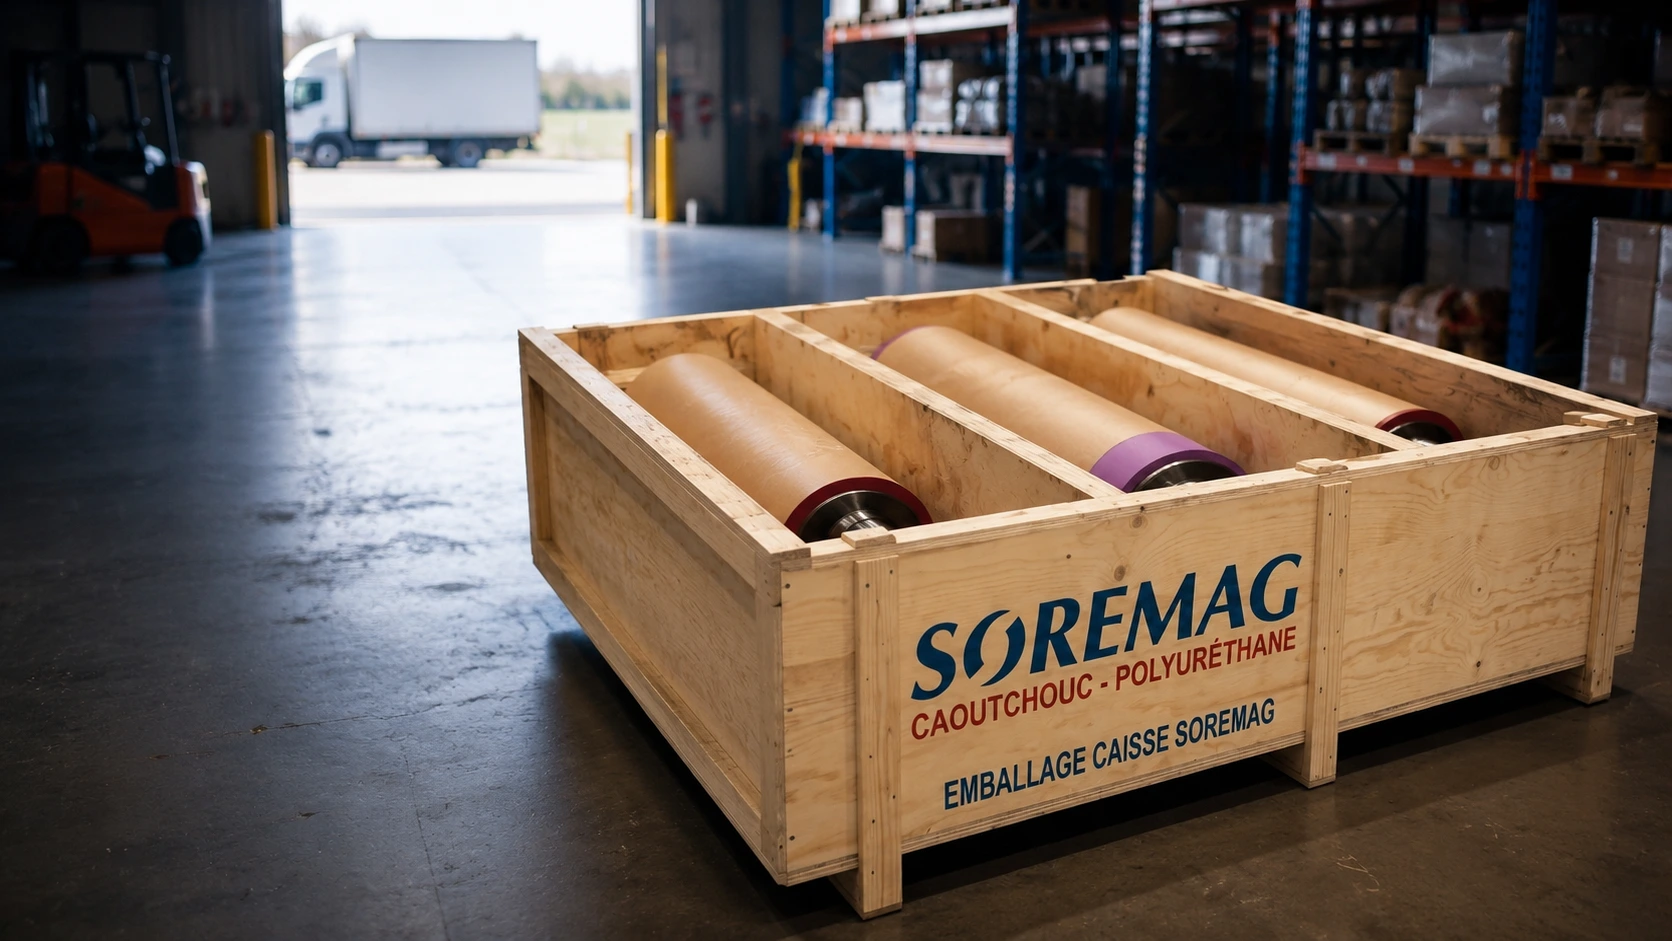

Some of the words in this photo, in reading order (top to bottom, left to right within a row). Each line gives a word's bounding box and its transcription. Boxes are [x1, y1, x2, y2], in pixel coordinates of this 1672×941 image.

[911, 553, 1302, 700] SOREMAG
[911, 673, 1094, 740] CAOUTCHOUC
[1115, 626, 1297, 691] POLYURÉTHANE
[944, 747, 1087, 810] EMBALLAGE
[1093, 725, 1170, 769] CAISSE
[1175, 698, 1276, 747] SOREMAG
